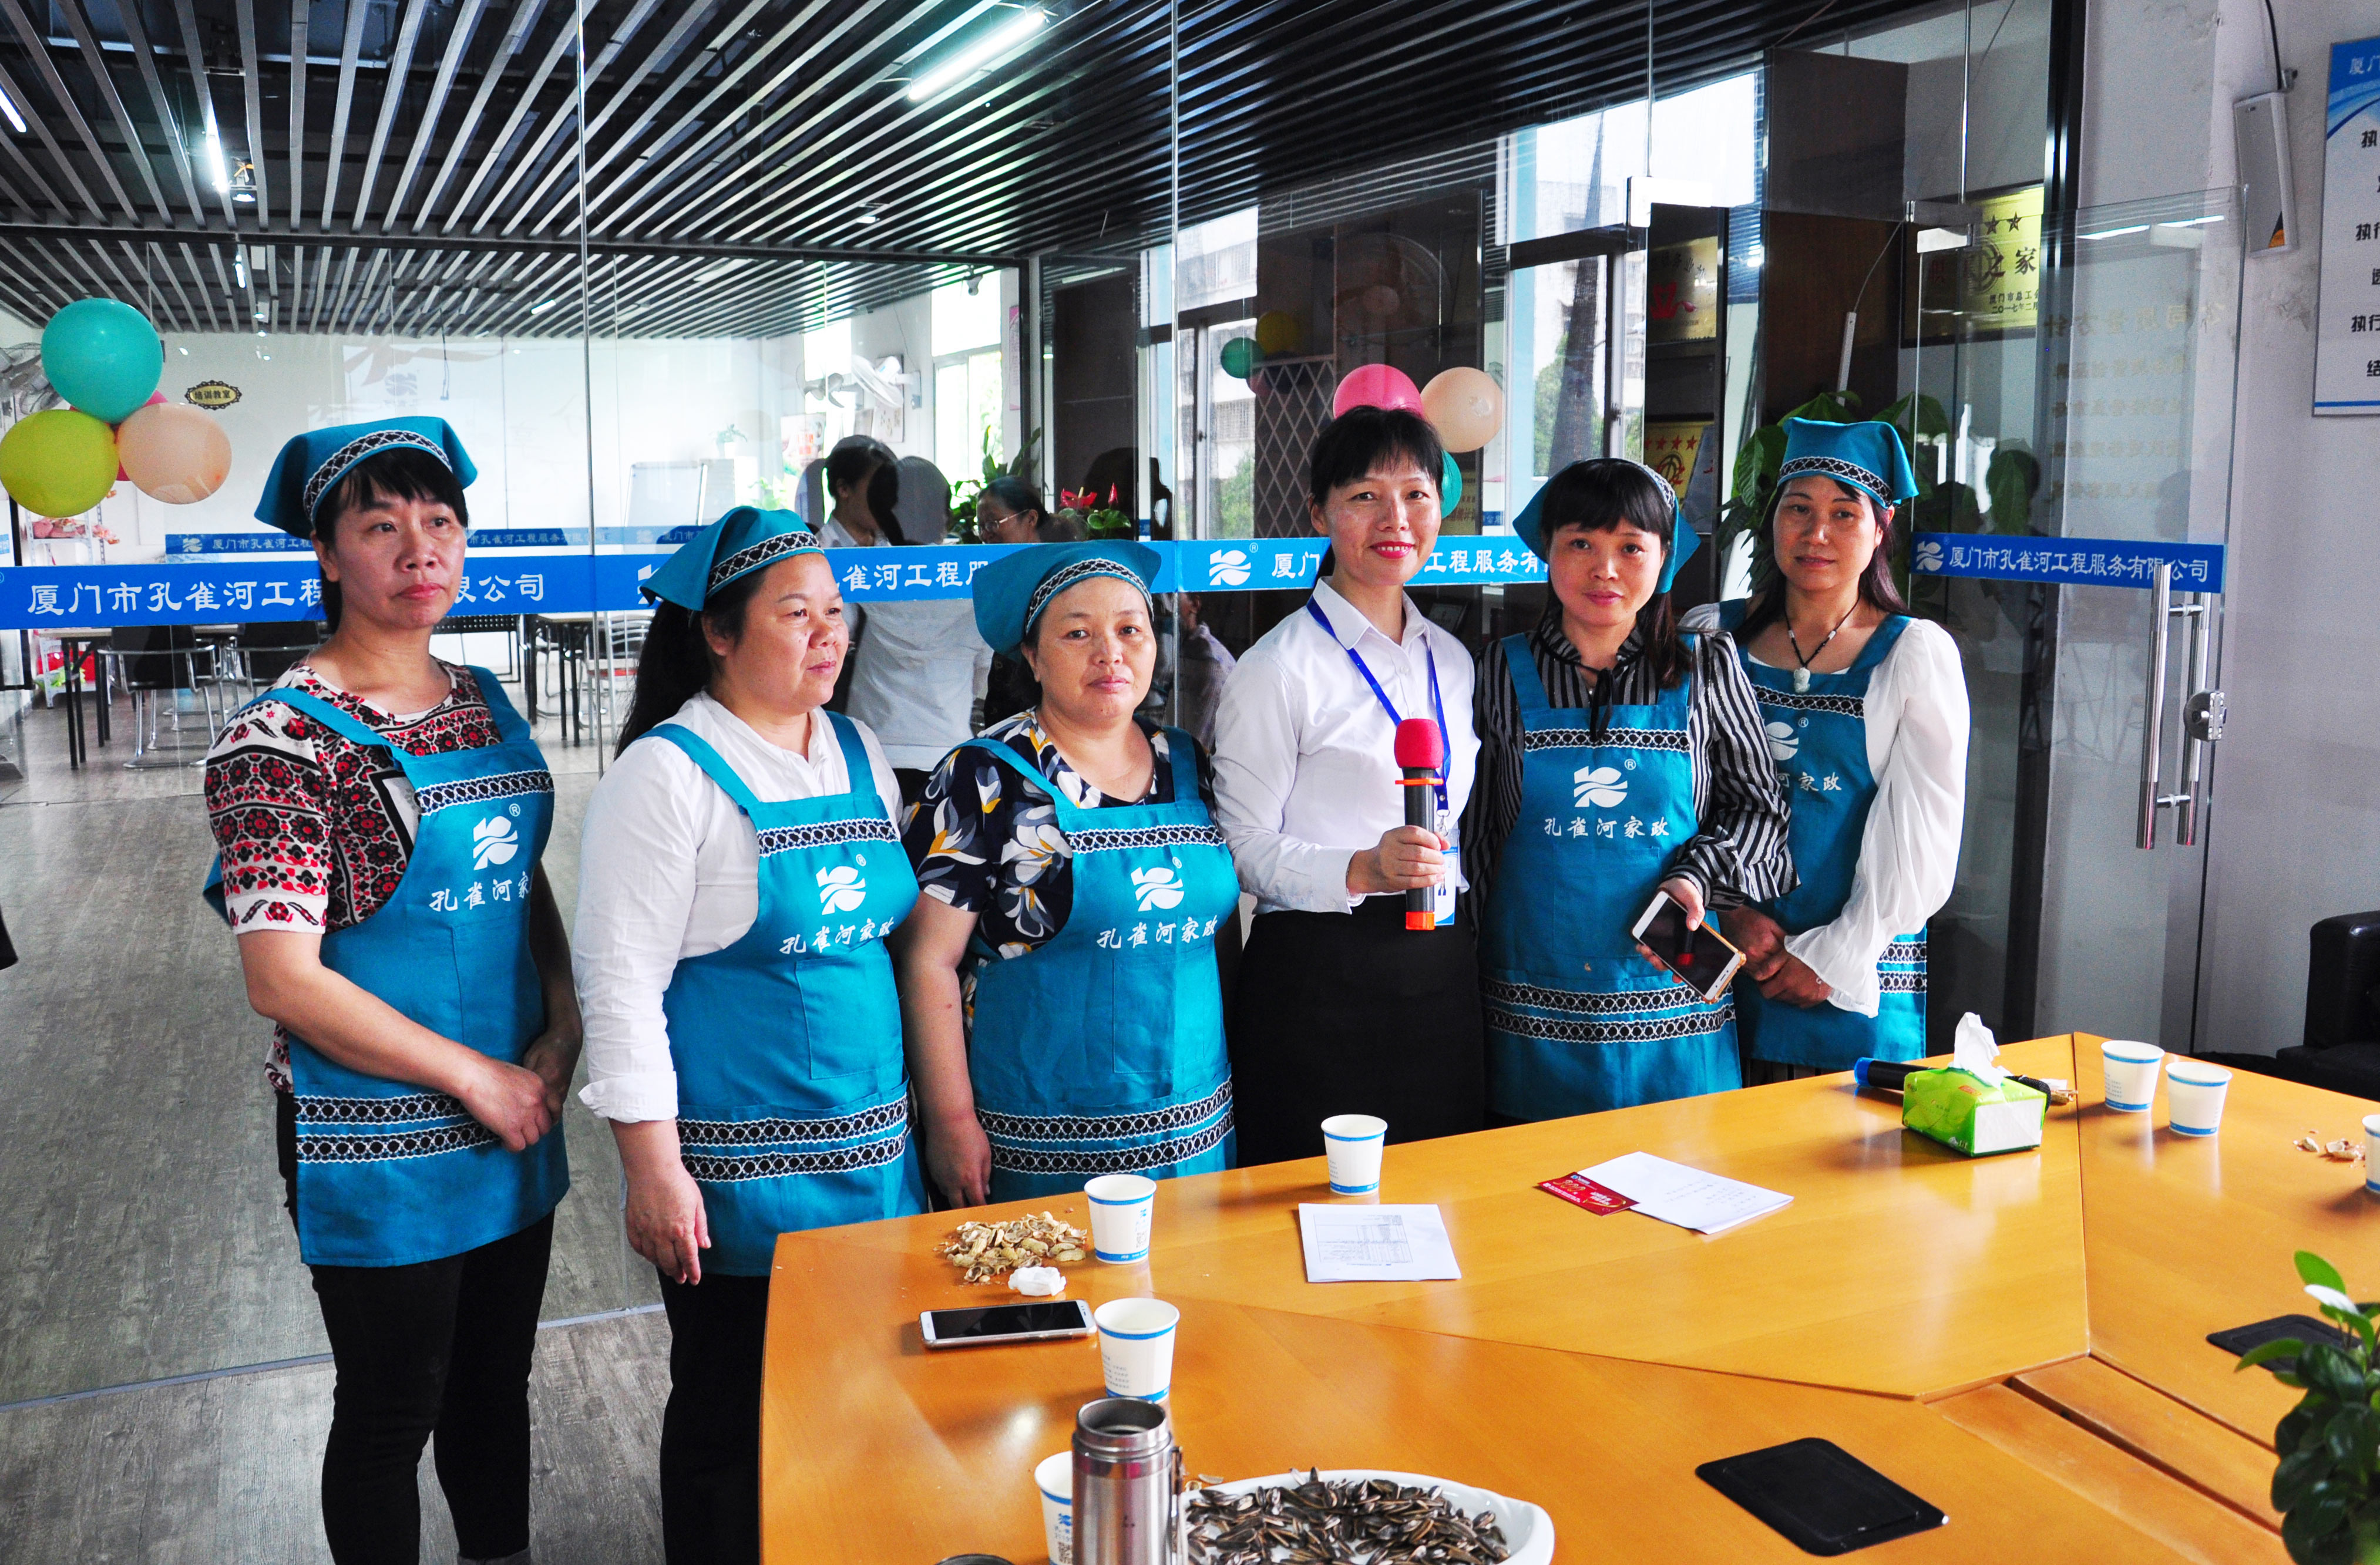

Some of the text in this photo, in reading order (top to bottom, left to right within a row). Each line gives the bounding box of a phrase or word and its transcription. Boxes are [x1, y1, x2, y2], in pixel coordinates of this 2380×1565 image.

[1424, 549, 1548, 574] 工程服务有
[1949, 546, 2208, 583] 厦门市孔雀河工程服务有限公司
[1544, 815, 1669, 839] 孔雀河家政
[1097, 915, 1218, 949] 孔雀河家政
